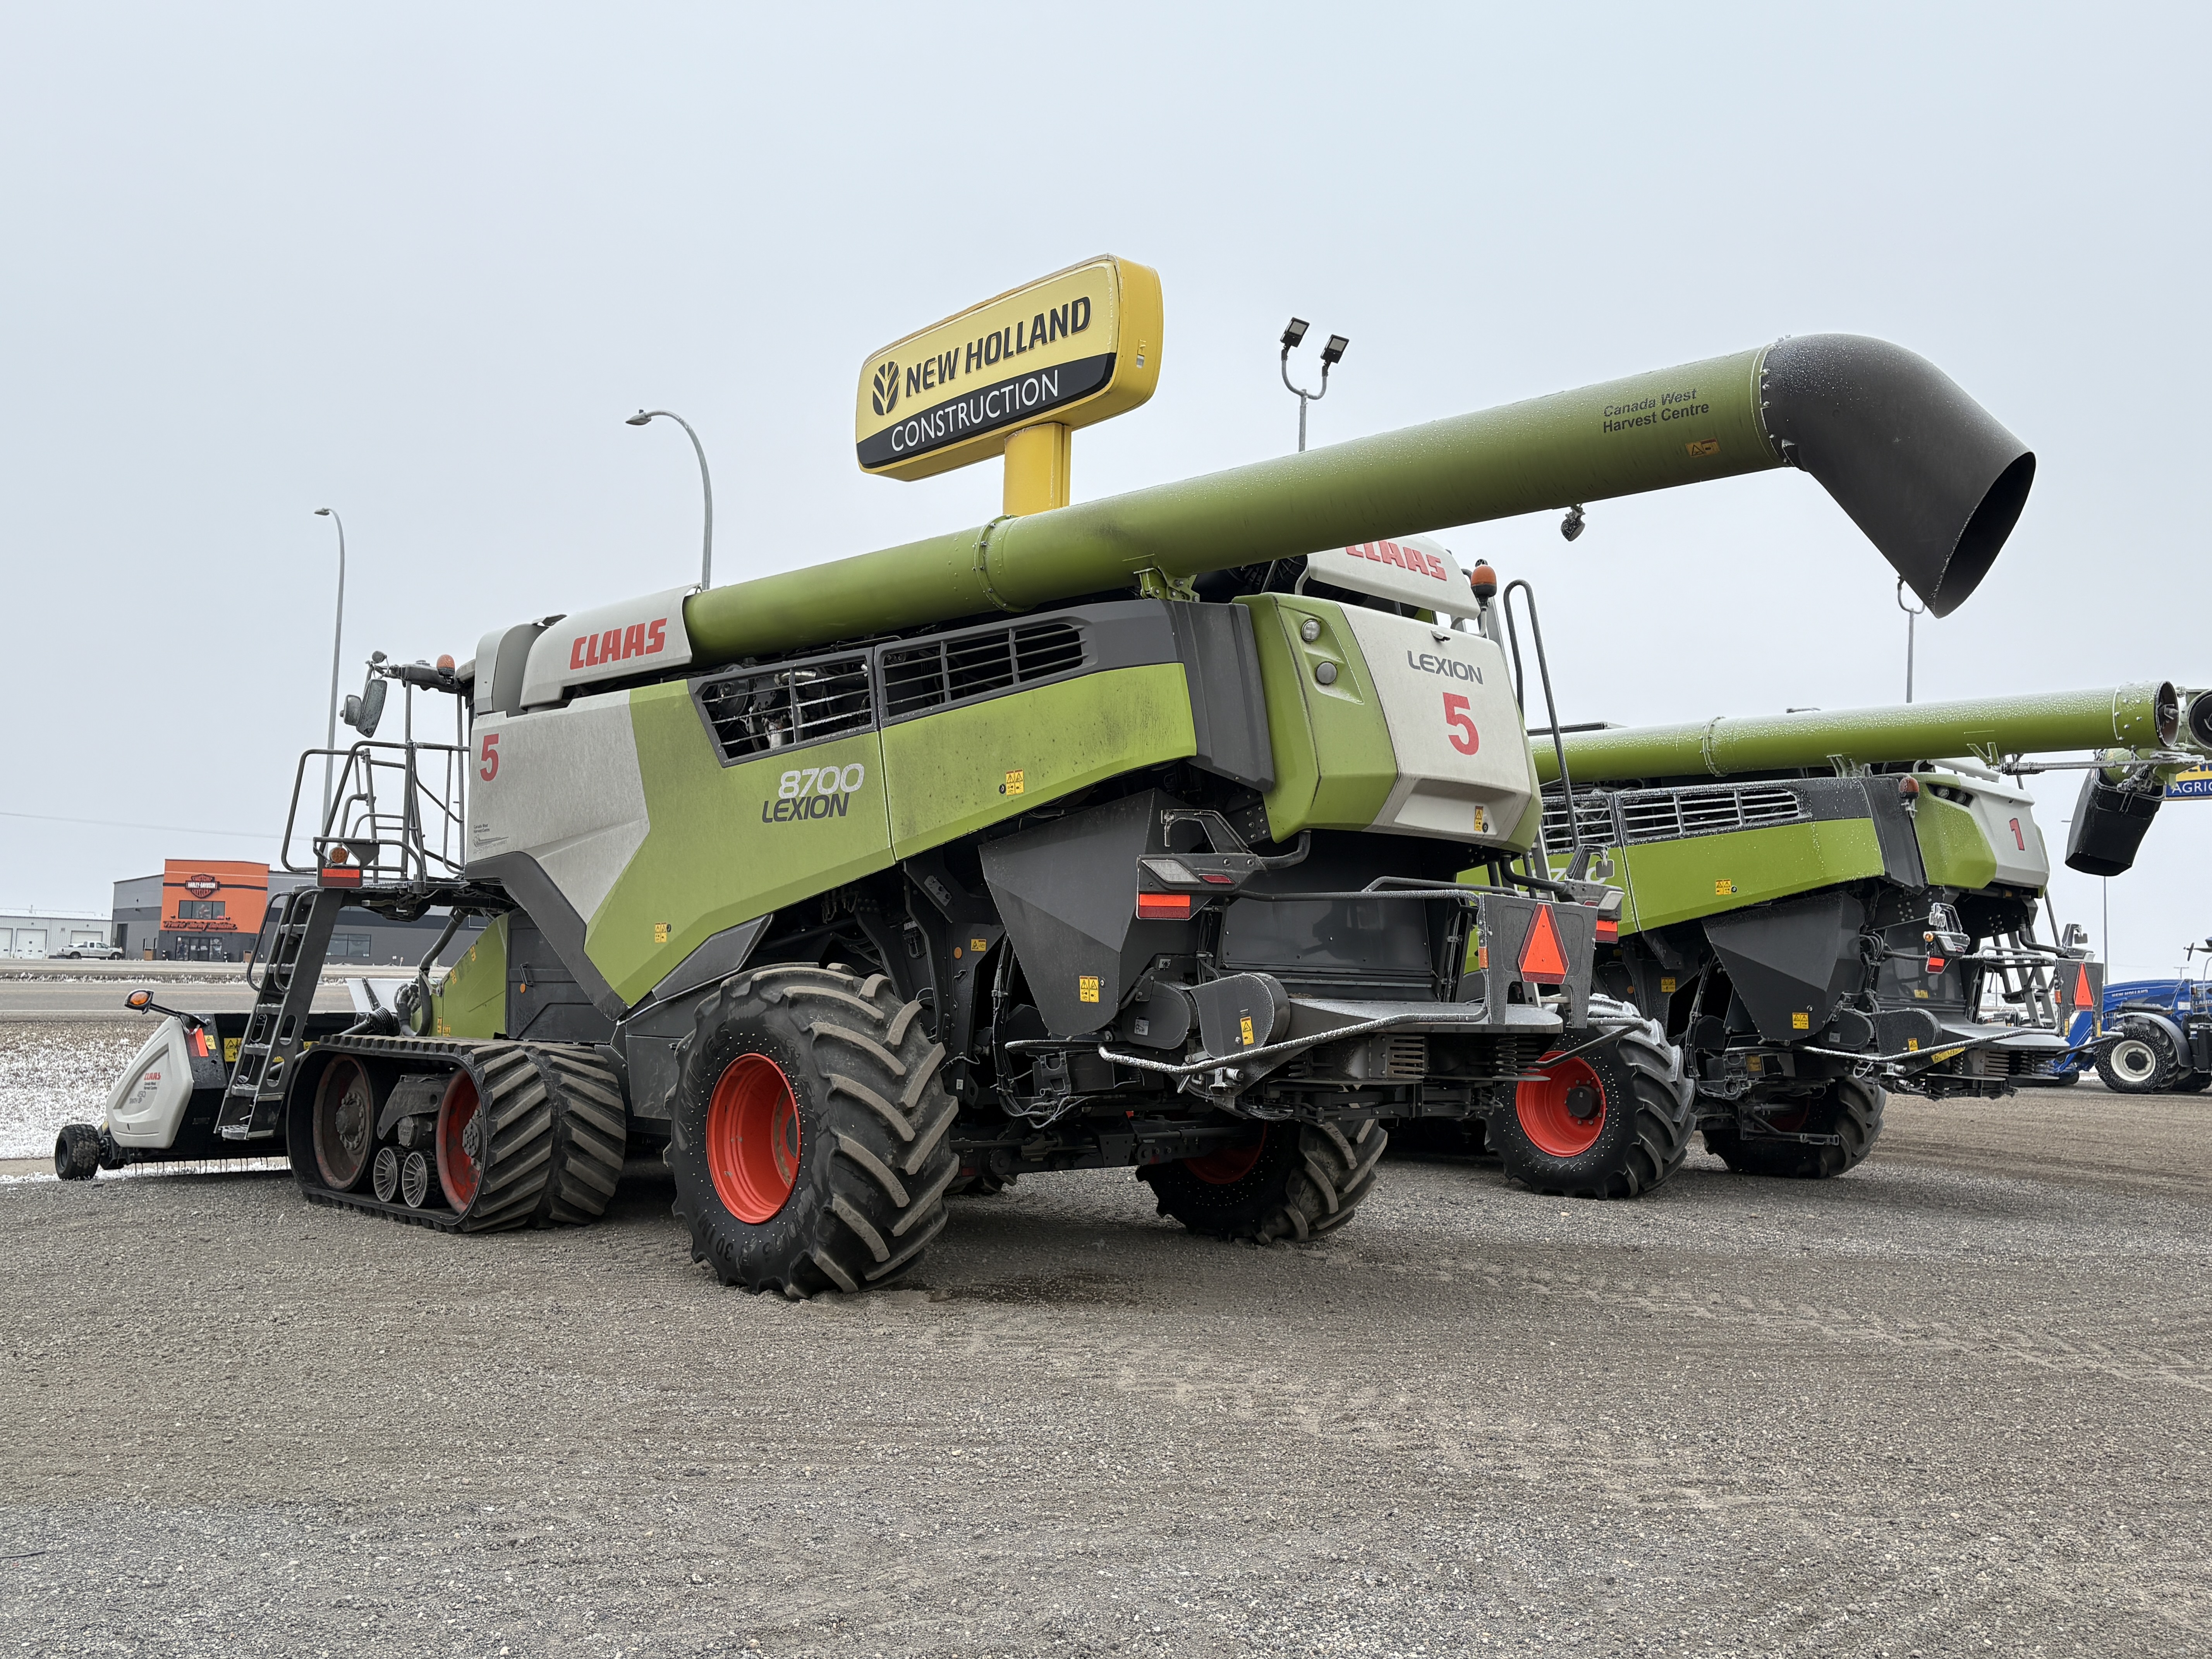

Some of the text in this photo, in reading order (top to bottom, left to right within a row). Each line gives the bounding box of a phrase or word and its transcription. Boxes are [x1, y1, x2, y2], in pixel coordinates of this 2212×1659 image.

[906, 296, 1091, 398] NEW HOLLAND
[891, 369, 1058, 452] CONSTRUCTION
[1603, 388, 1697, 417] Canada West
[1603, 403, 1709, 433] Harvest Centre
[569, 617, 667, 670] CLAAS
[1407, 650, 1483, 685] LEXION
[1442, 692, 1480, 756] 5
[479, 733, 500, 782] 5
[778, 763, 865, 799] 8700
[762, 792, 850, 823] LEXION
[2009, 818, 2025, 851] 1
